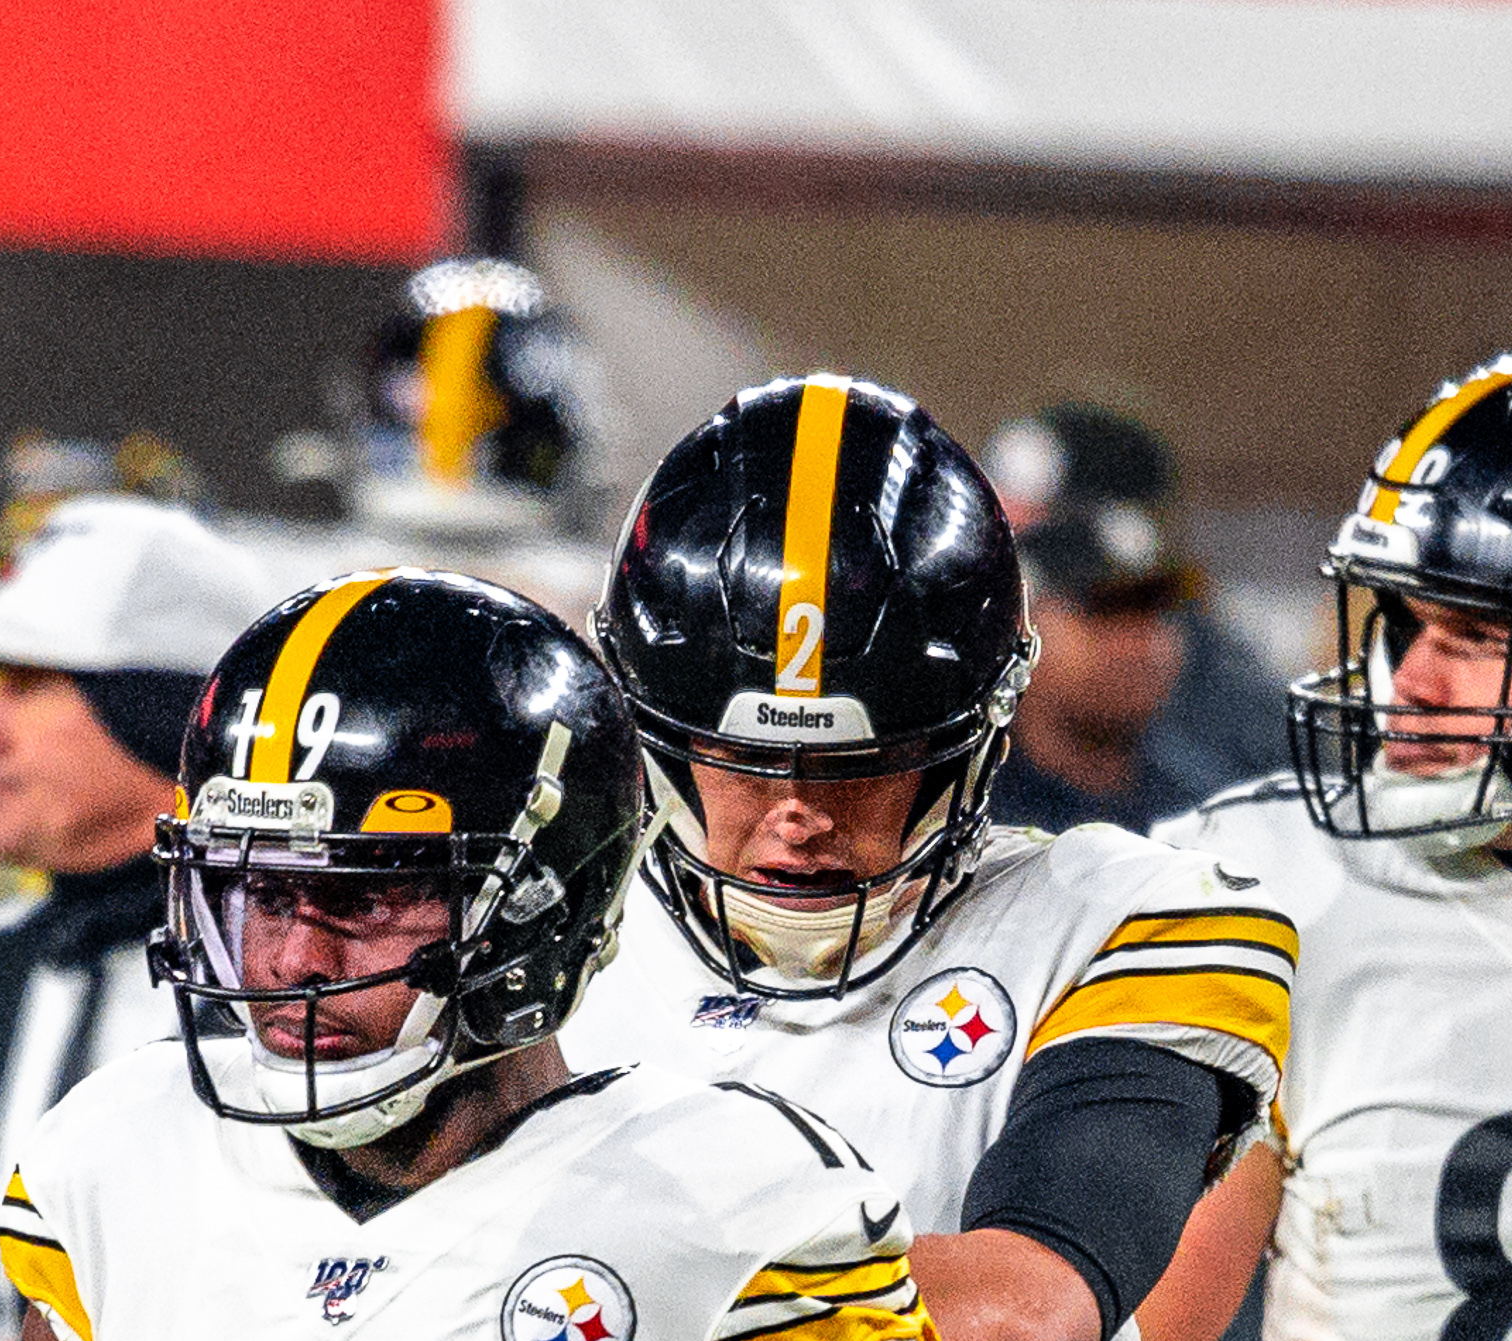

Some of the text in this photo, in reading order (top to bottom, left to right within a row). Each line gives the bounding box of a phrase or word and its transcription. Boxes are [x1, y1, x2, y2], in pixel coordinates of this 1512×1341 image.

[775, 602, 825, 691] 2
[756, 702, 835, 729] Steelers
[231, 688, 340, 781] 19
[227, 787, 294, 819] Steelers
[902, 1018, 948, 1034] Steelers
[517, 1298, 566, 1327] Steelers
